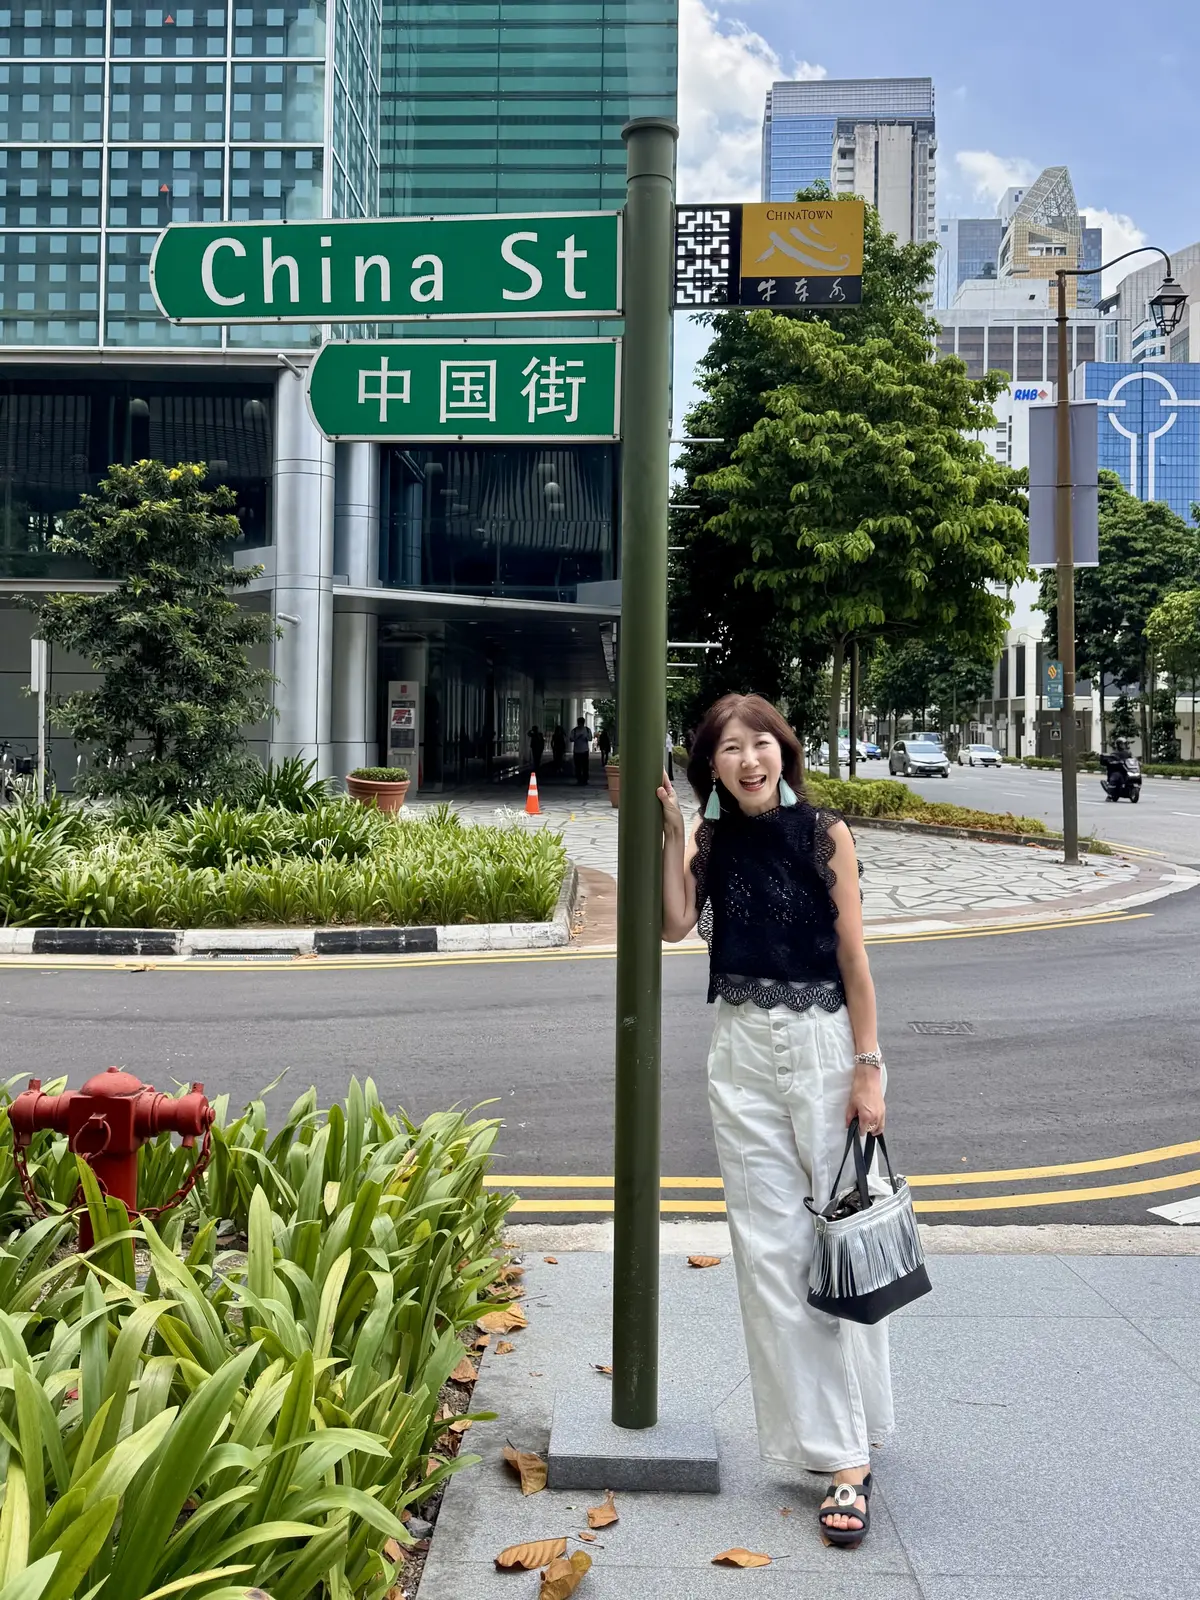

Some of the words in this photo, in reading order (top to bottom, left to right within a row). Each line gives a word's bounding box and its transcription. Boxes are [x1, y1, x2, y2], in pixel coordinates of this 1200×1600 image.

[201, 236, 444, 306] China
[500, 231, 588, 301] St
[357, 356, 587, 423] 中国街
[1014, 389, 1038, 401] RHB
